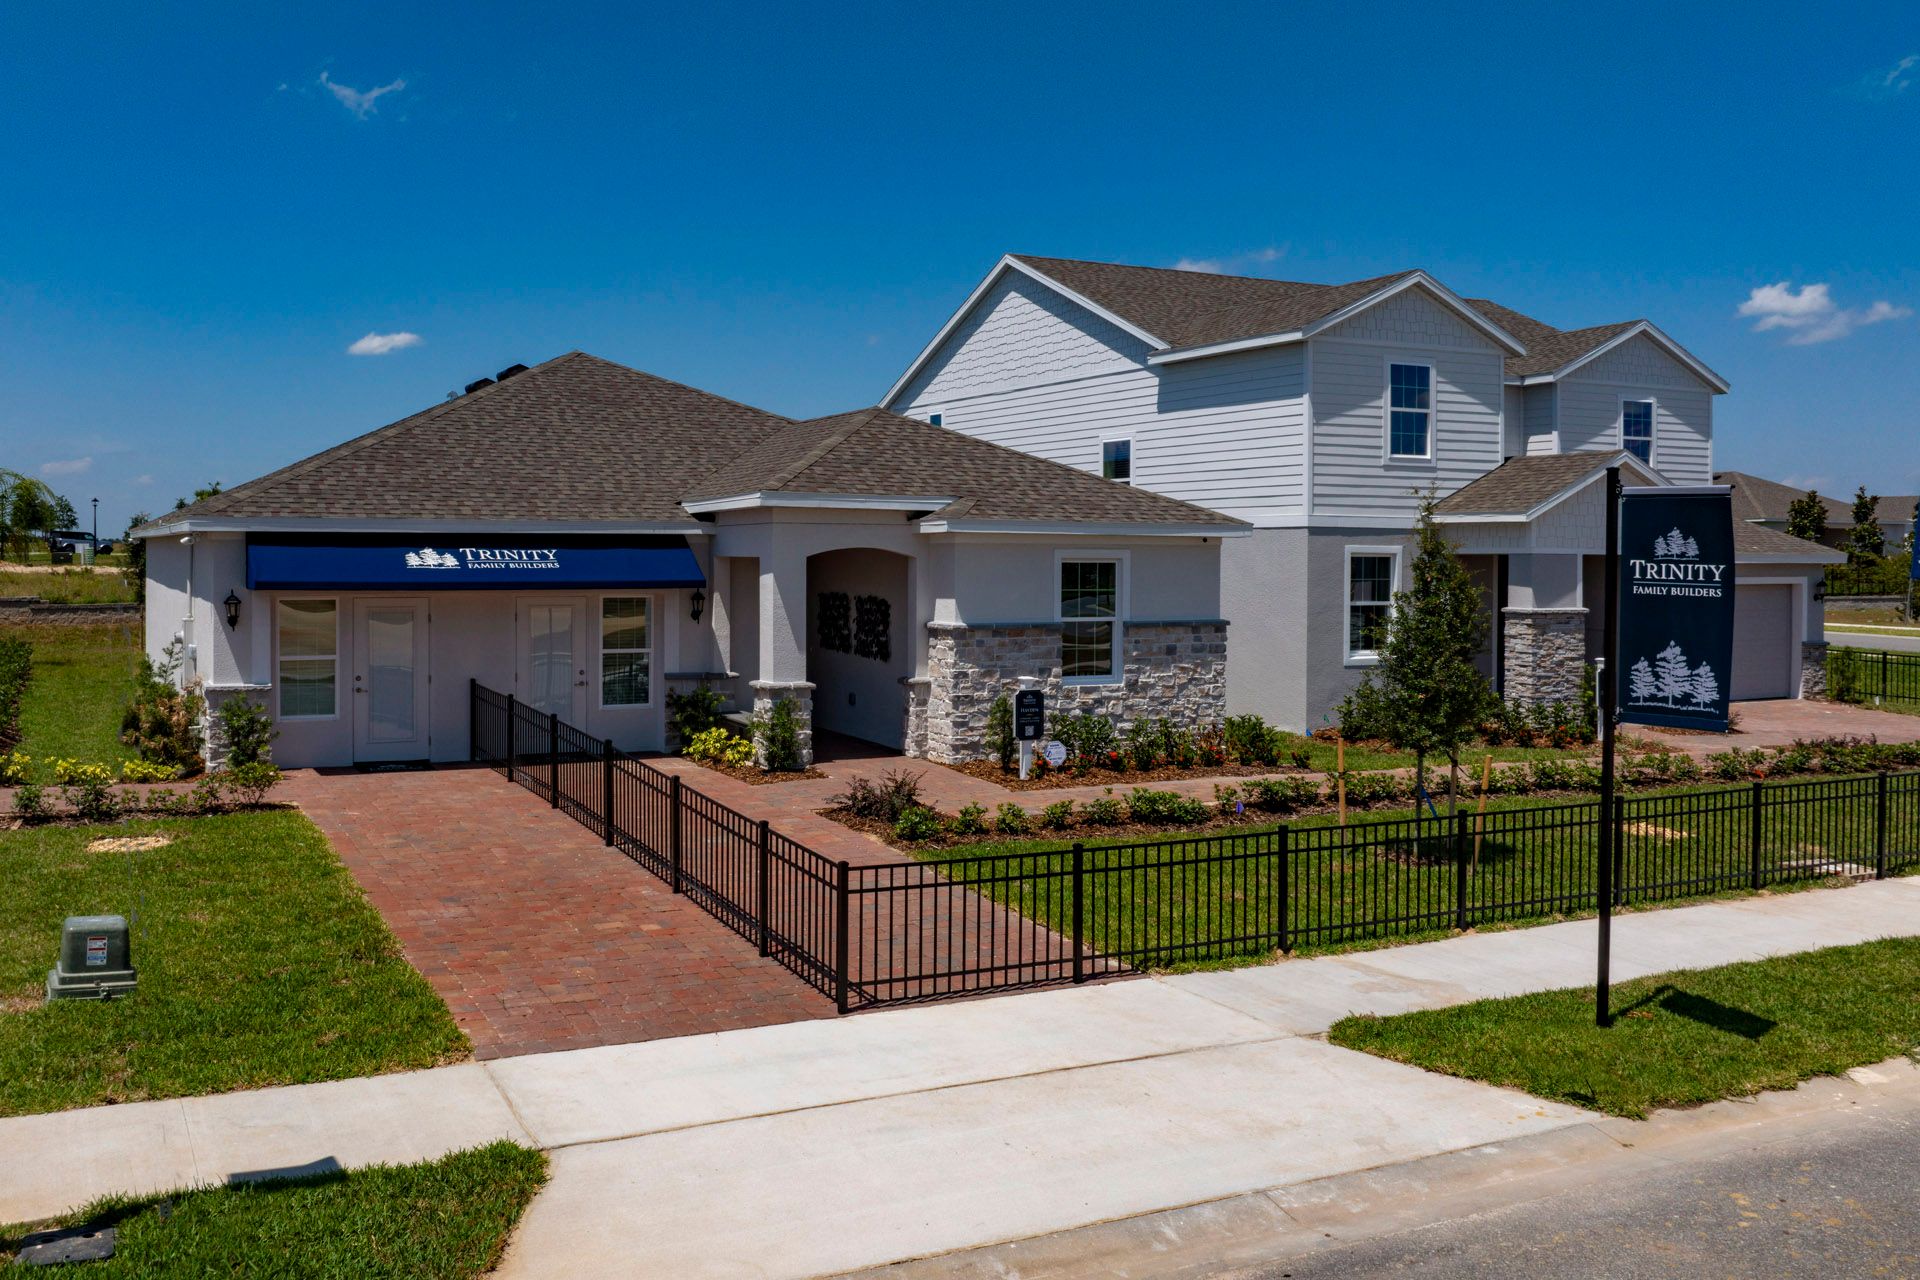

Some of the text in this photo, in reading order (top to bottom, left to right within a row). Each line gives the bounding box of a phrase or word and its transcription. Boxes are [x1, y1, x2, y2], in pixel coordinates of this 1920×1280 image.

[459, 548, 557, 560] TRINITY
[1630, 559, 1726, 581] TRINITY
[1633, 585, 1722, 597] FAMILY BUILDERS
